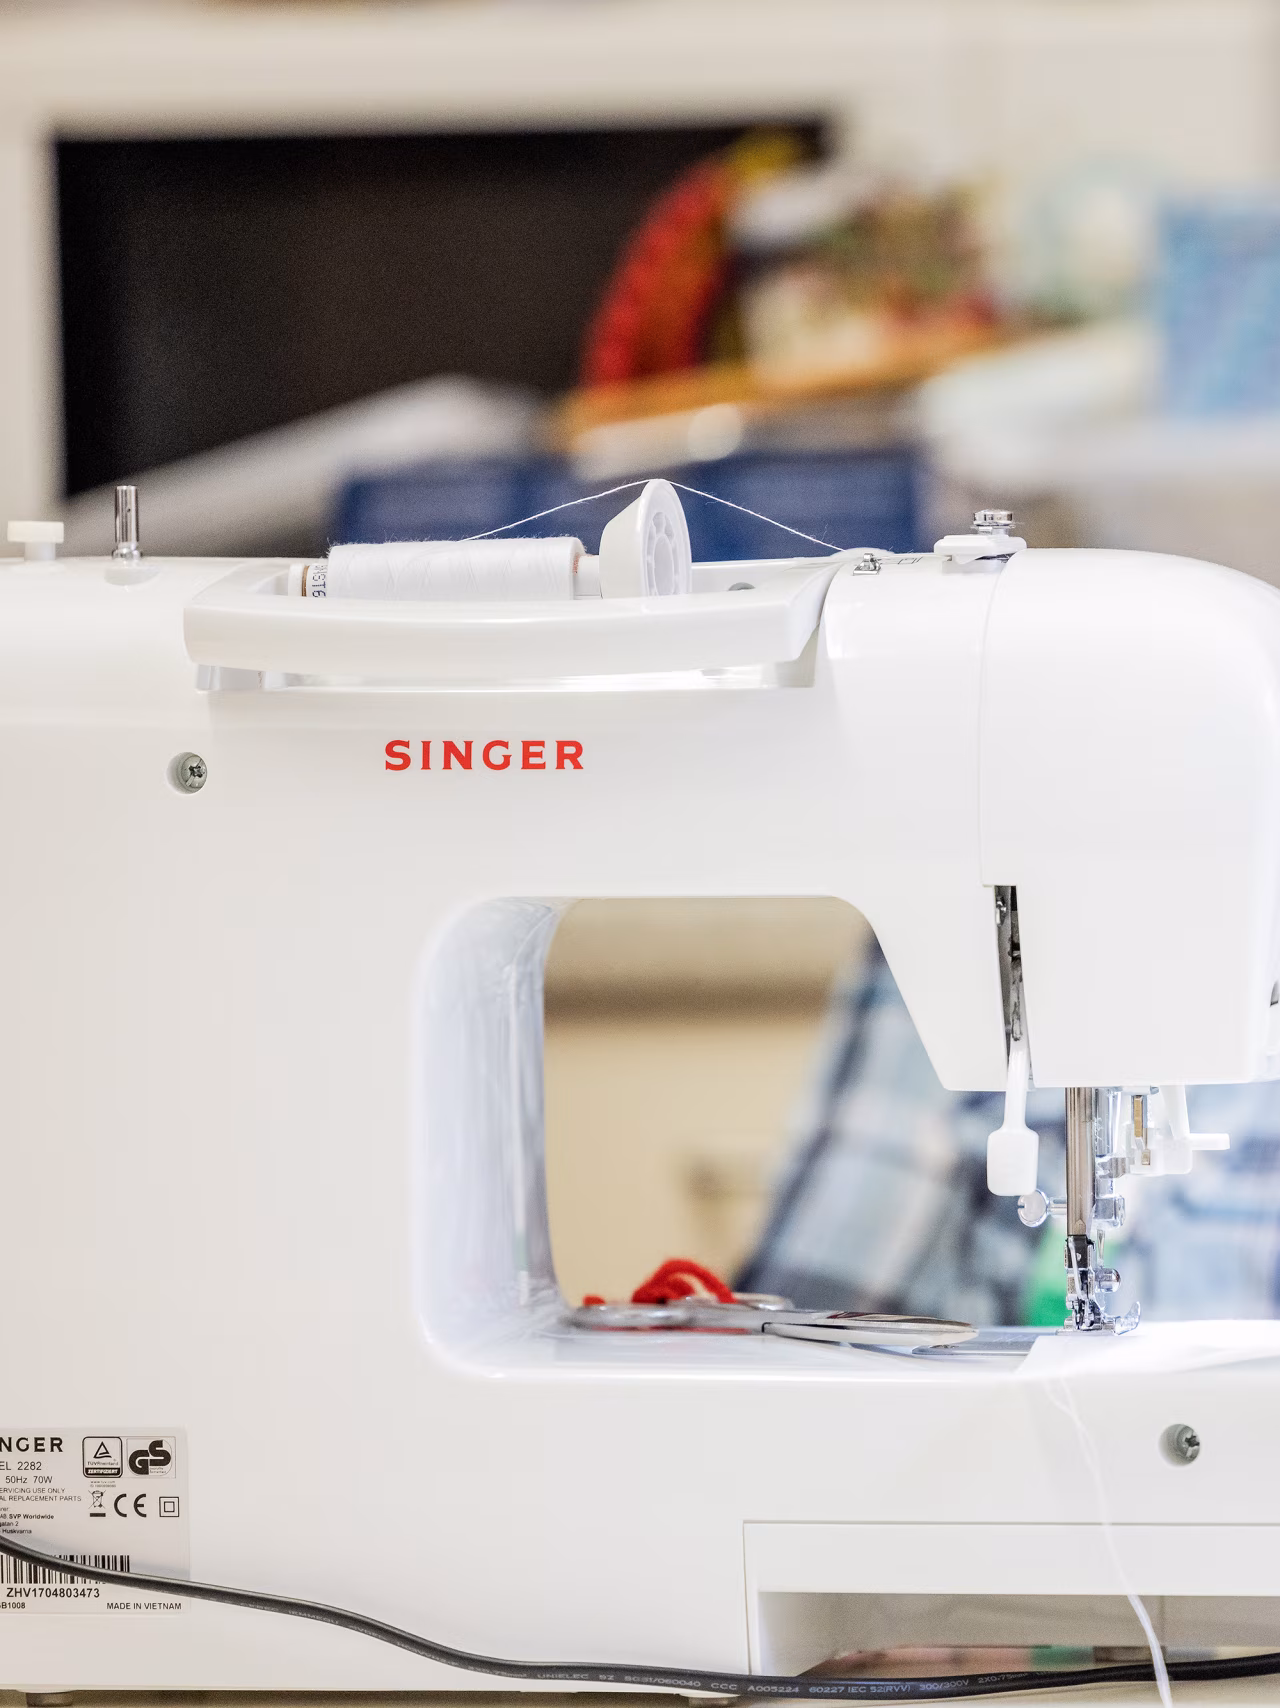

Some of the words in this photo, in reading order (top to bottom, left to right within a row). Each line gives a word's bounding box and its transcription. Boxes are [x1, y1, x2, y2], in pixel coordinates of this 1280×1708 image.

[384, 739, 584, 771] SINGER
[17, 1461, 42, 1471] 2282
[5, 1476, 28, 1484] 50Hz
[33, 1476, 53, 1484] 70W
[114, 1493, 147, 1518] CE
[6, 1588, 100, 1598] ZHV1704803473
[710, 1682, 738, 1691] CCC
[869, 1684, 911, 1693] 52(RVV)
[919, 1679, 970, 1691] 300/300V
